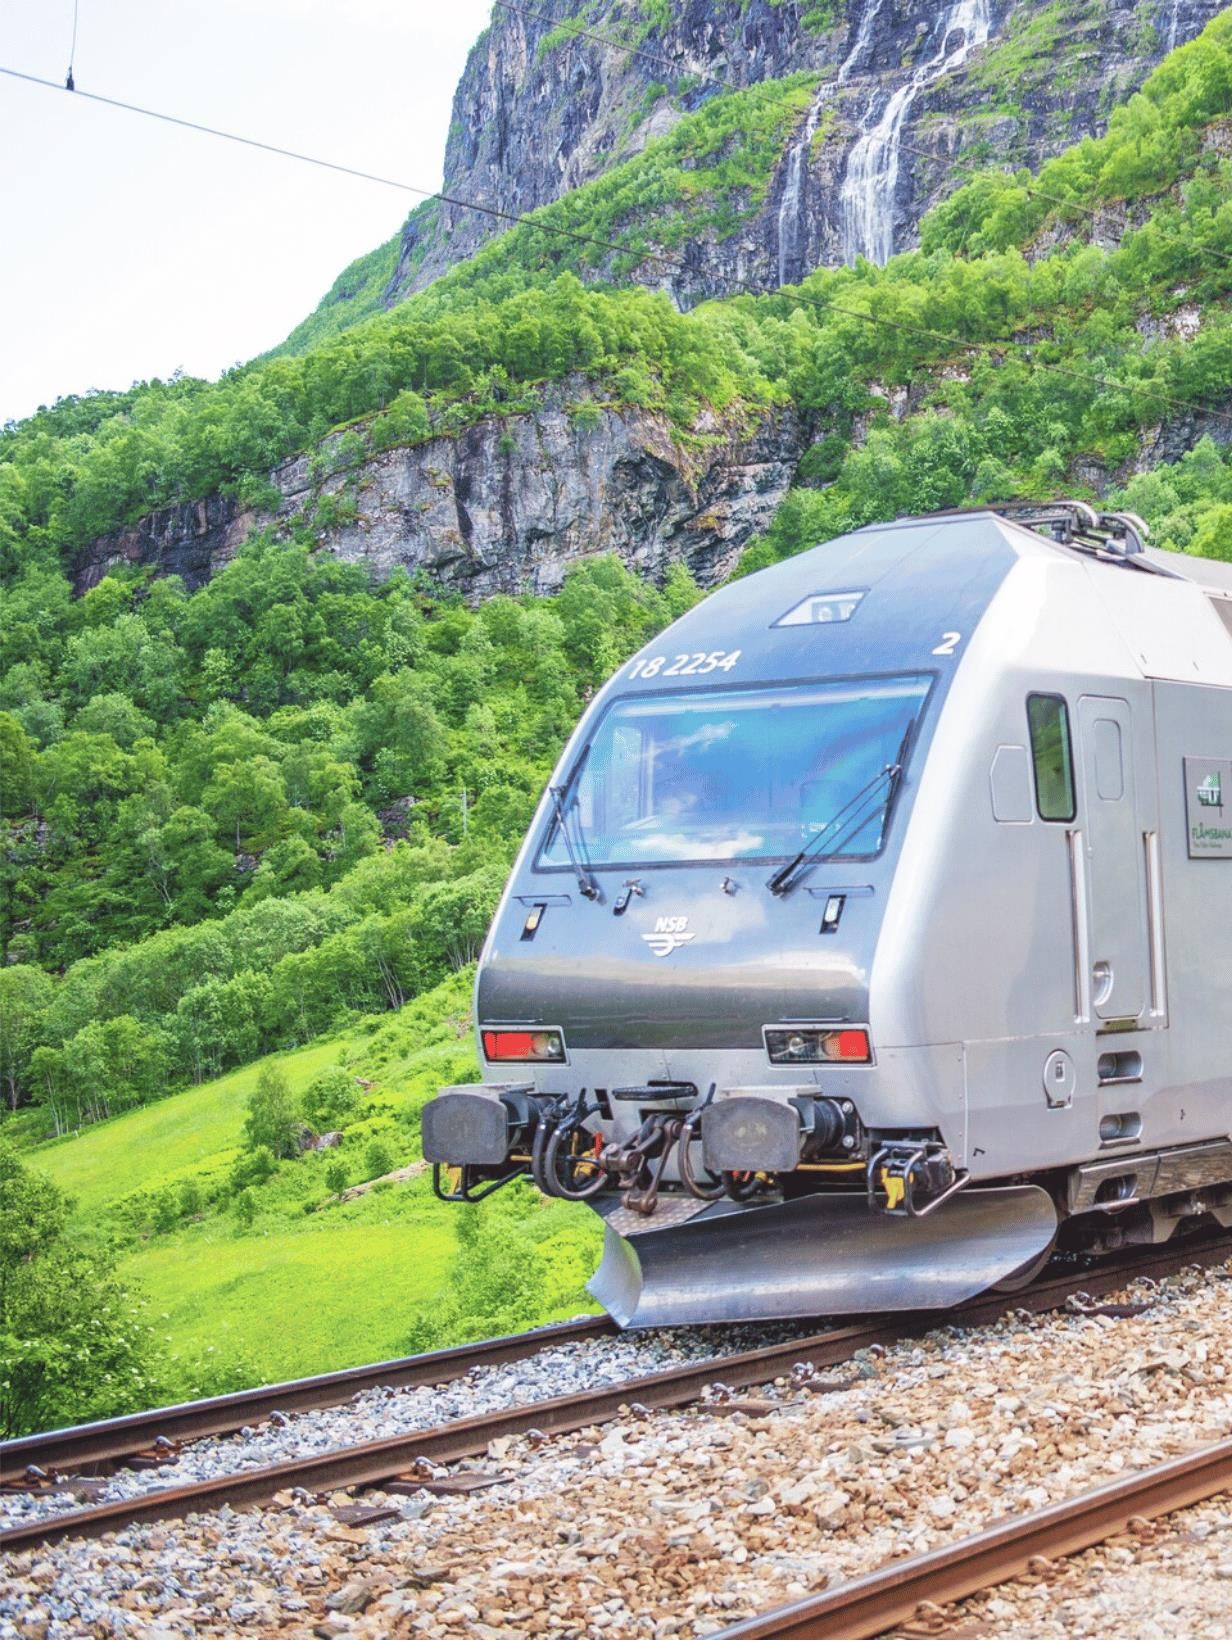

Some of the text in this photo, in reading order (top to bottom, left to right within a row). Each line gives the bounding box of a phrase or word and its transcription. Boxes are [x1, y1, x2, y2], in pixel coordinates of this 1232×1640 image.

[931, 631, 961, 656] 2
[628, 649, 742, 679] 18 2254
[654, 916, 689, 932] NSB
